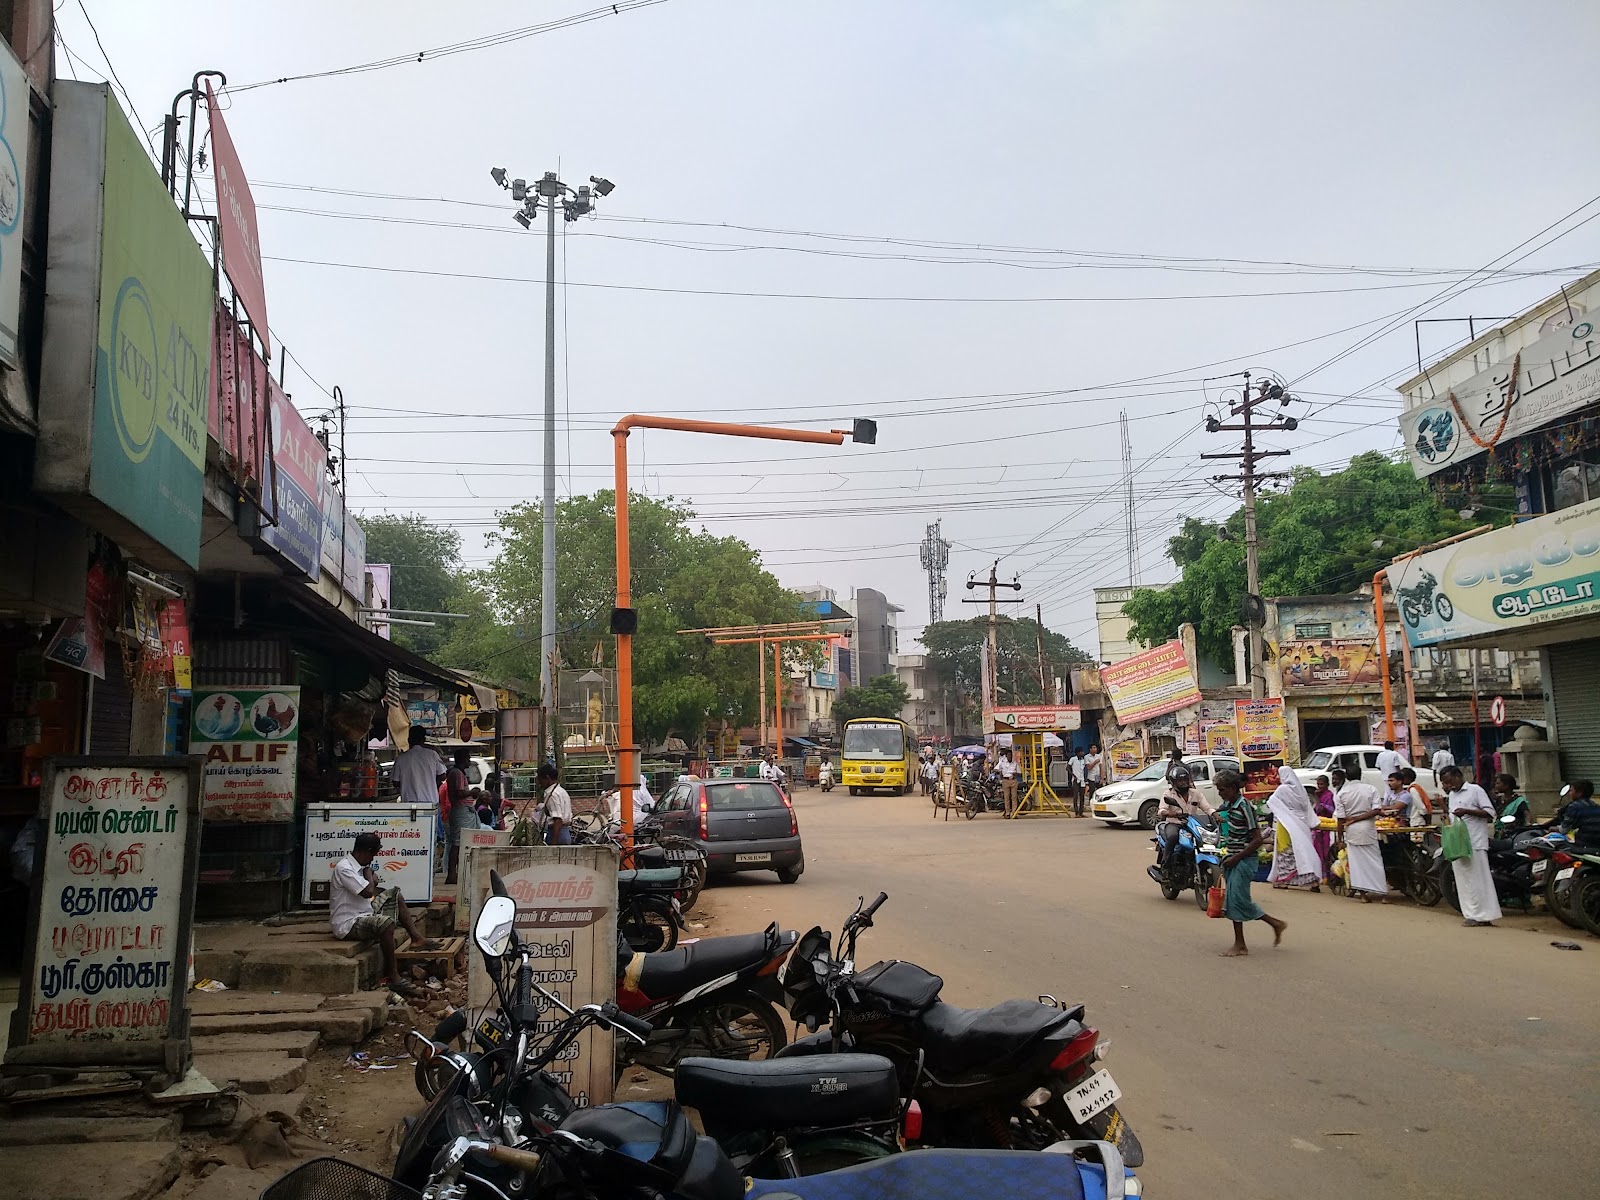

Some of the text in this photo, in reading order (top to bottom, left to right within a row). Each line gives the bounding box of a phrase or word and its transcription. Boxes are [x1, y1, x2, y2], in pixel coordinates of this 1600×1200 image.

[119, 329, 152, 401] KVB
[162, 320, 209, 425] ATM
[166, 391, 200, 454] 24 Hrs.
[281, 428, 317, 481] ALIF
[64, 645, 81, 660] 4G
[173, 640, 185, 656] 4G
[1018, 714, 1055, 724] ஆனந்தம்
[207, 743, 289, 763] ALIF
[54, 803, 179, 838] டிபன் சென்டர்
[67, 842, 147, 876] இட்லி
[60, 885, 158, 917] தோசை
[507, 875, 595, 904] ஆனந்த்
[527, 939, 571, 958] இட்லி
[479, 1020, 503, 1045] R.K.
